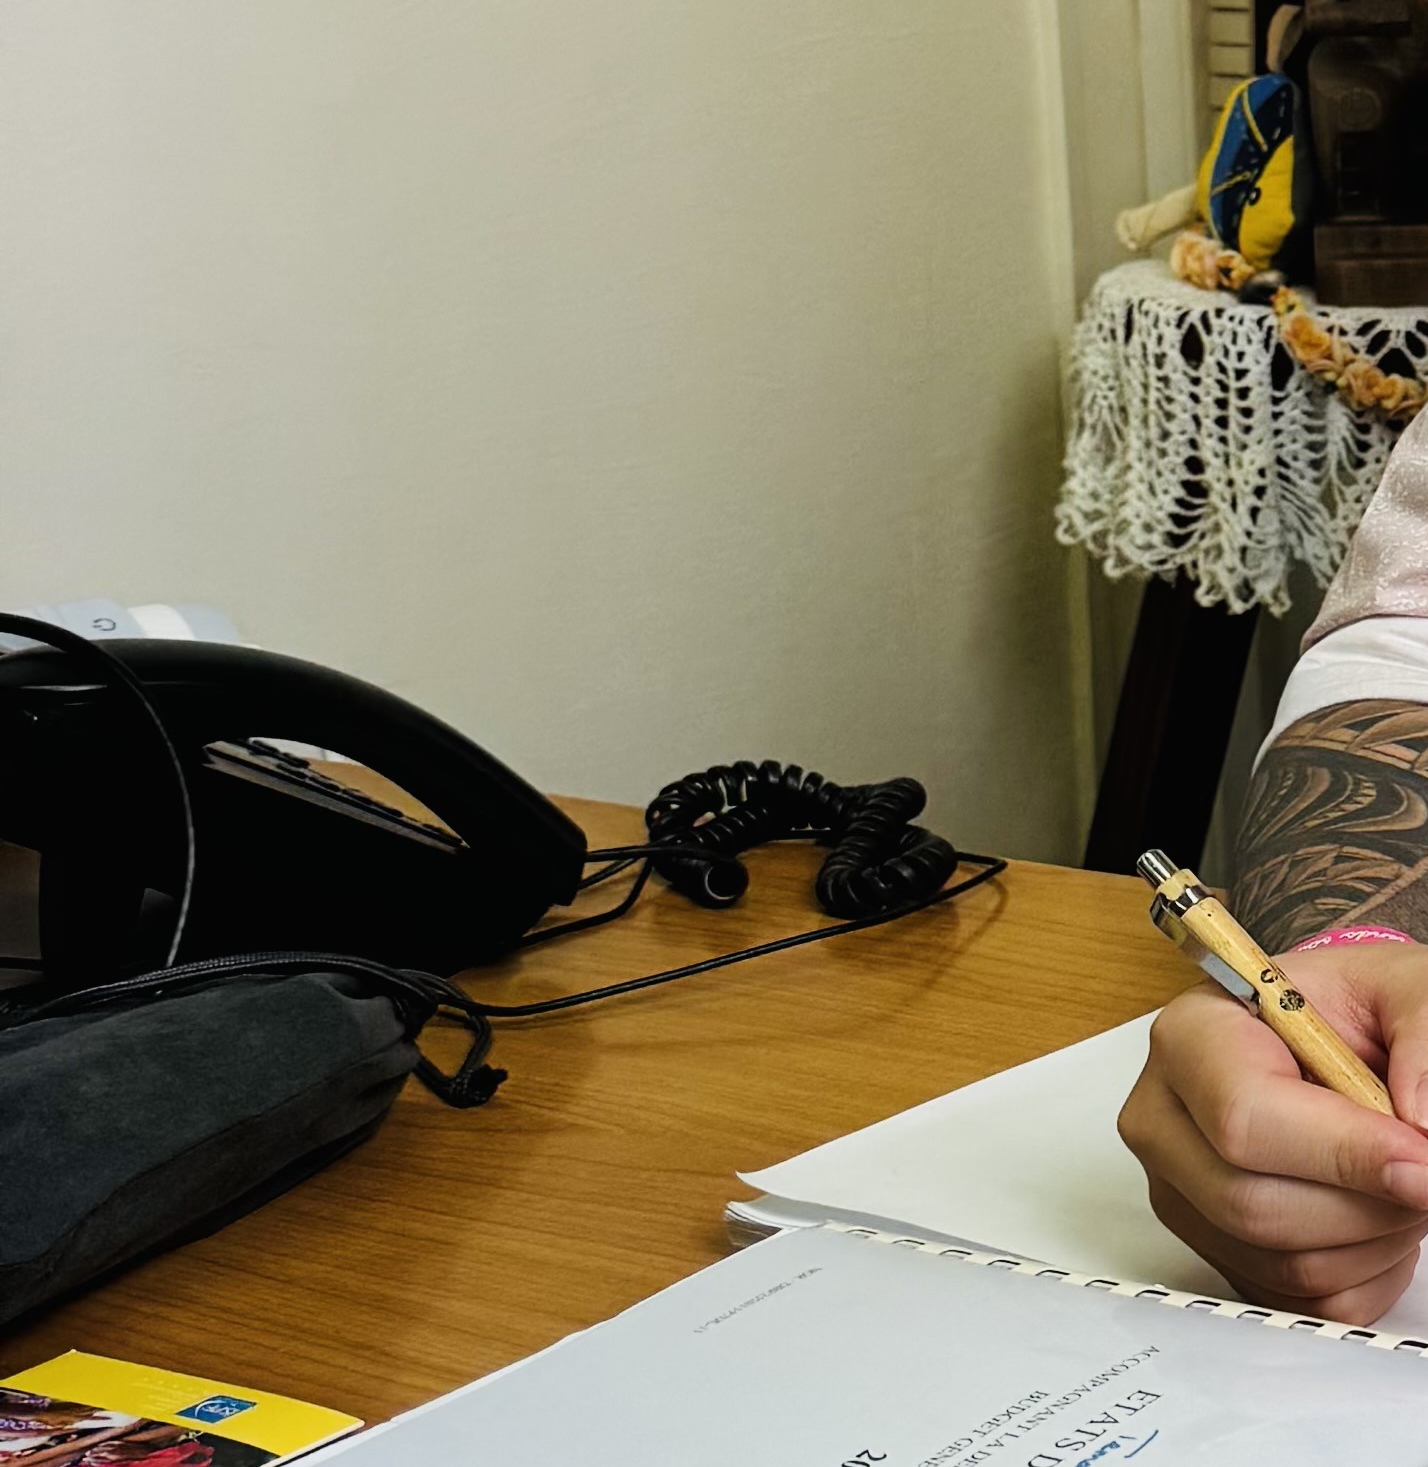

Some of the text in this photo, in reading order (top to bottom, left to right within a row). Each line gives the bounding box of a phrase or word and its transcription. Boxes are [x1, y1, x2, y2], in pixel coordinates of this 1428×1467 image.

[972, 1389, 1051, 1438] BUDGET
[1015, 1344, 1161, 1434] ACCOMPAGNANT
[986, 1431, 1020, 1448] LA
[1027, 1389, 1163, 1467] ETATS D
